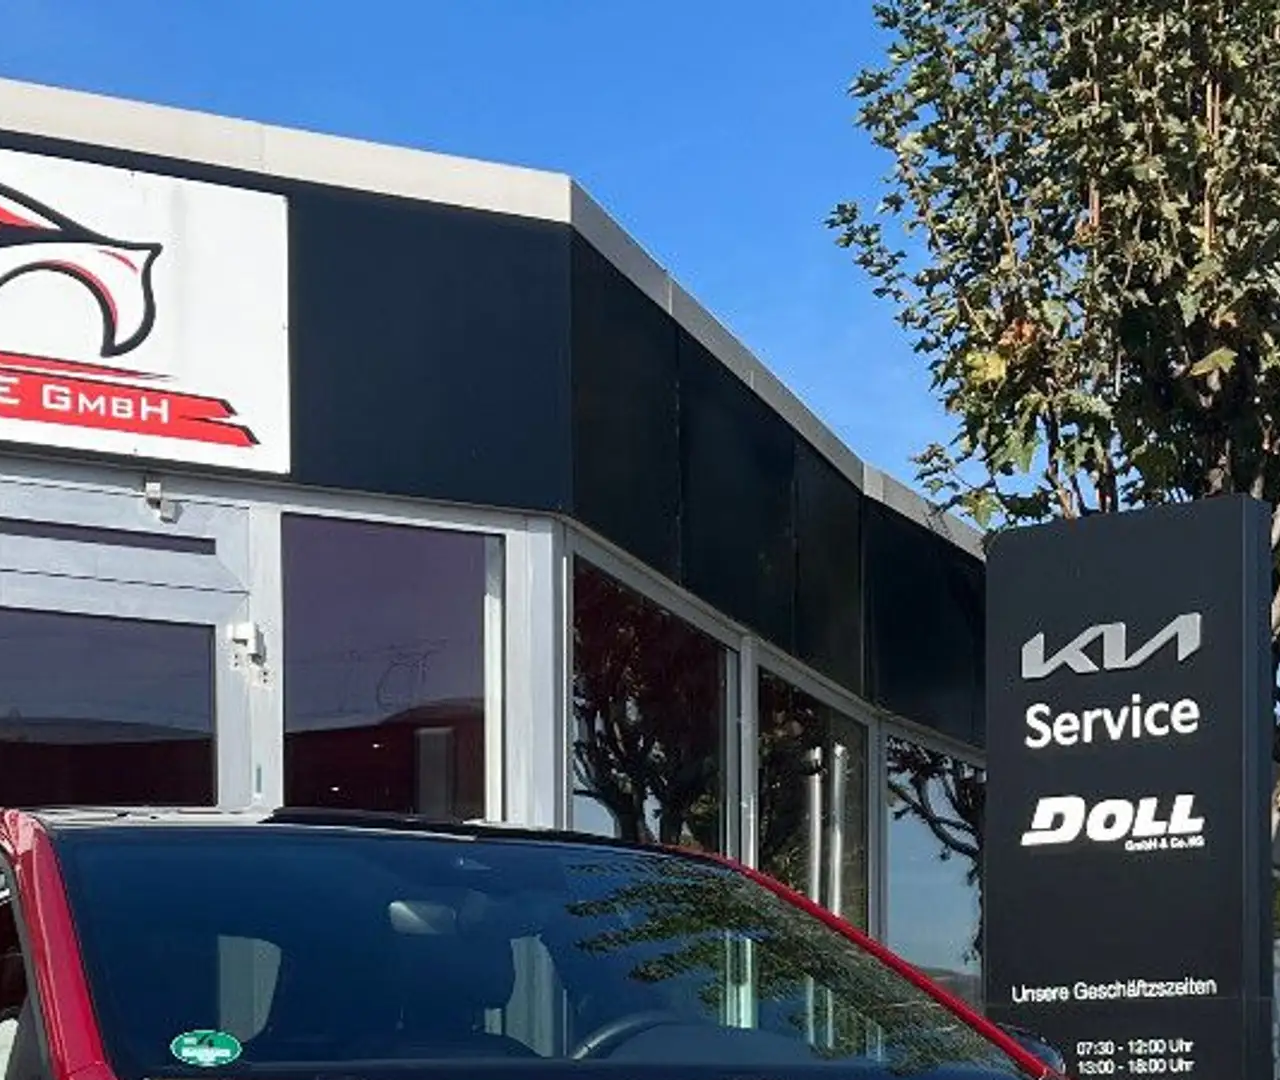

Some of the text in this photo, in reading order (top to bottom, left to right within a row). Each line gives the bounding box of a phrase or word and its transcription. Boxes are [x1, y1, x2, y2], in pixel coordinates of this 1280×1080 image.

[1021, 611, 1202, 680] KIA
[1024, 692, 1201, 749] Service
[1011, 983, 1069, 1003] Unsere
[1076, 1040, 1115, 1056] 07:30
[1127, 1039, 1167, 1055] 12:00
[1168, 1037, 1194, 1053] Uhr
[1168, 1057, 1195, 1073] Uhr
